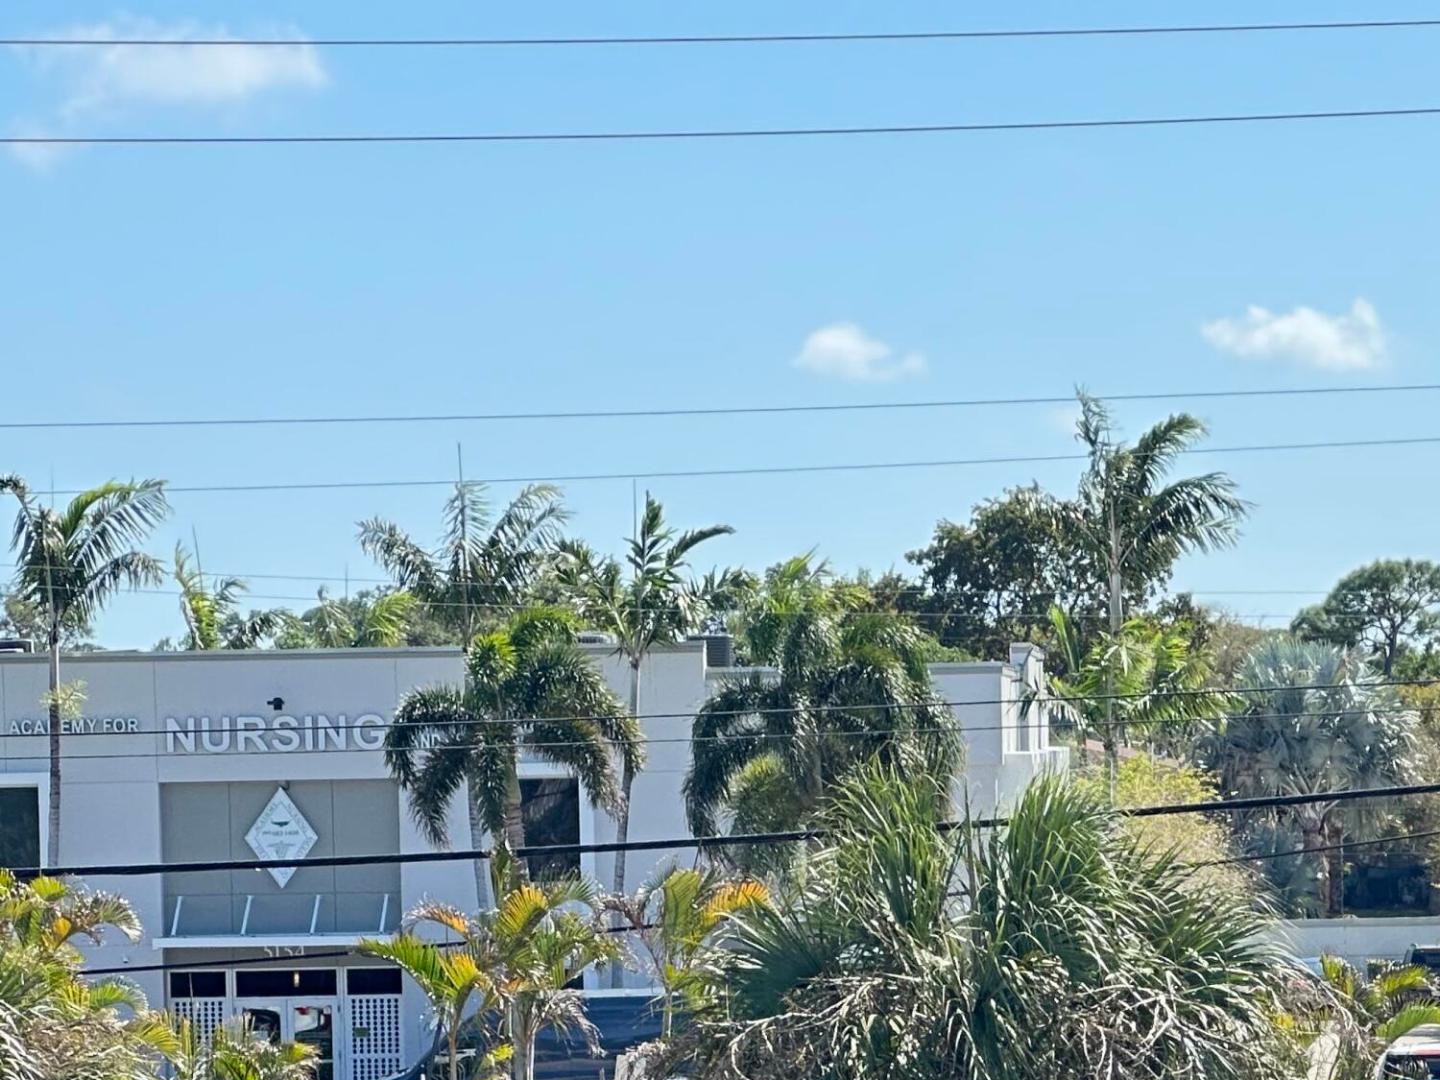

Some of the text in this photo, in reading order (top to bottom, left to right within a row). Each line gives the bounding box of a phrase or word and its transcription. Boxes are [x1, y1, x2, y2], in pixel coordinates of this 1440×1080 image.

[9, 719, 97, 735] ACAEMY
[103, 718, 139, 732] FOR
[165, 714, 386, 753] NURSING
